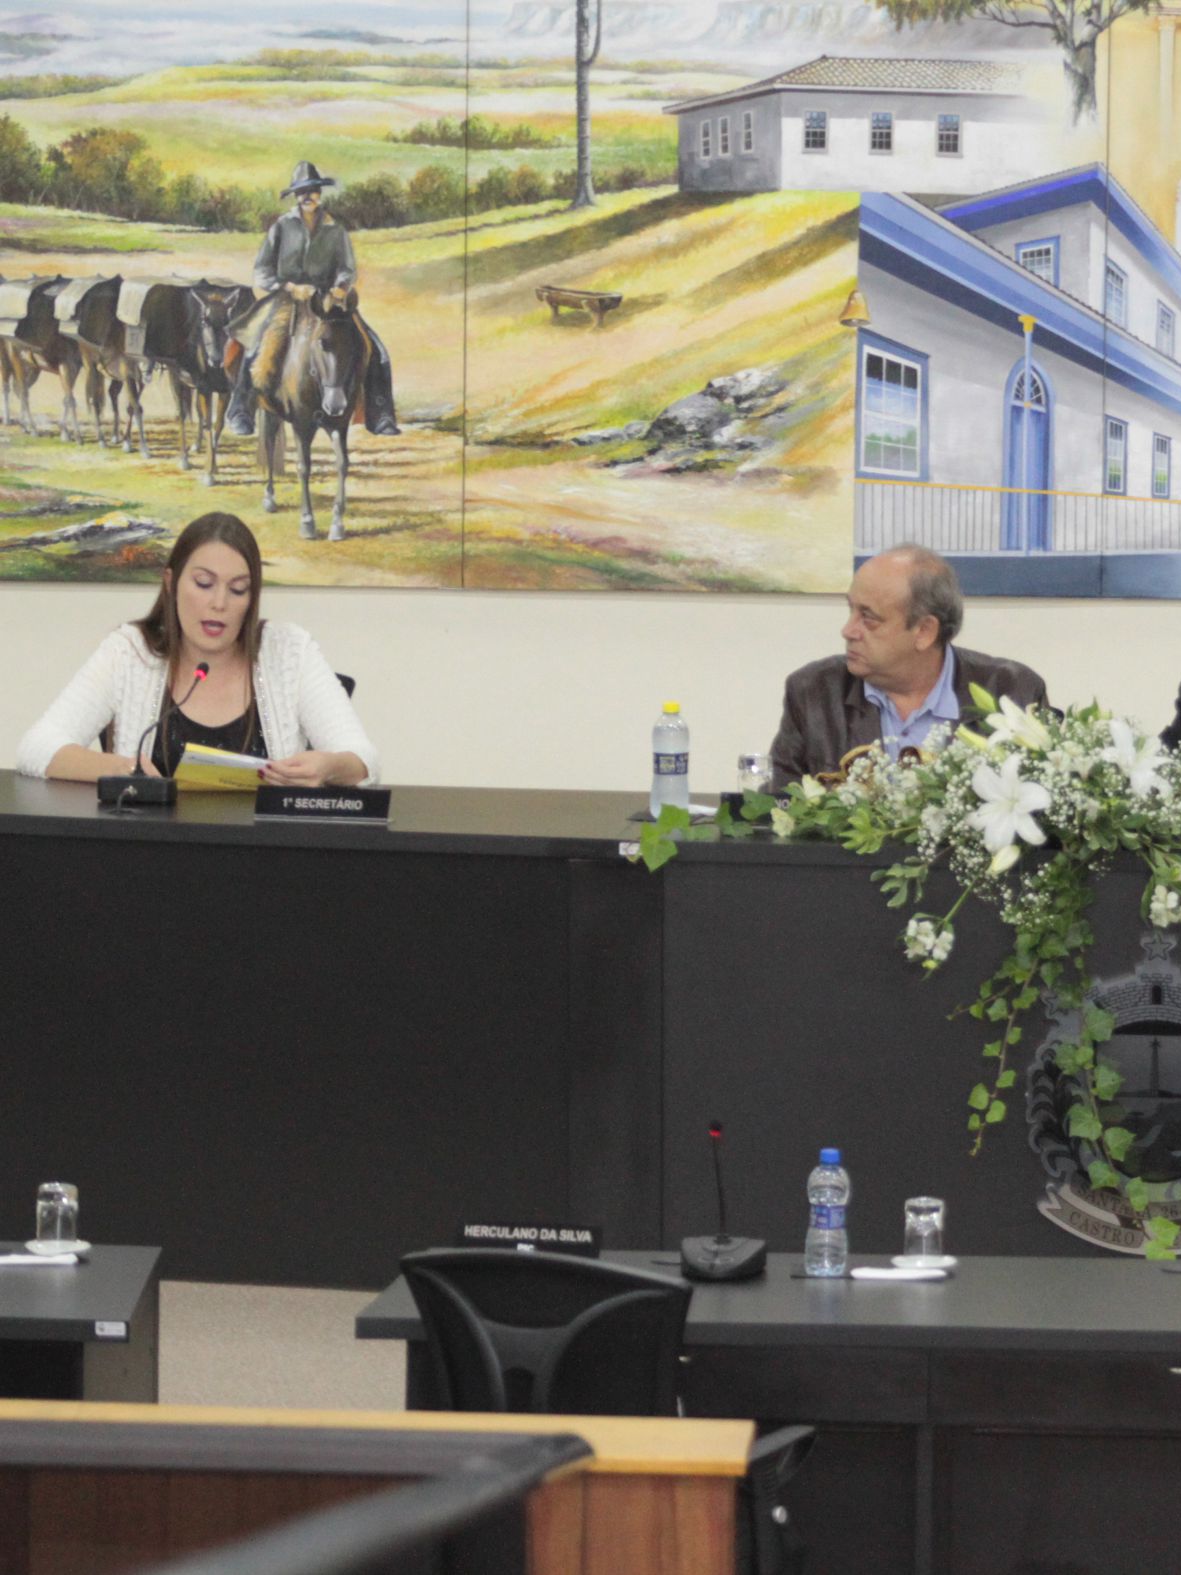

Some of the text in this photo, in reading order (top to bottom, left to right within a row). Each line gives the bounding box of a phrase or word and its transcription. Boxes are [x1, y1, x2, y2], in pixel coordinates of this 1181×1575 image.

[294, 797, 364, 810] SECRETÁRIO
[464, 1225, 592, 1242] HERCULANO DA SILVA
[1070, 1210, 1135, 1245] CASTRO
